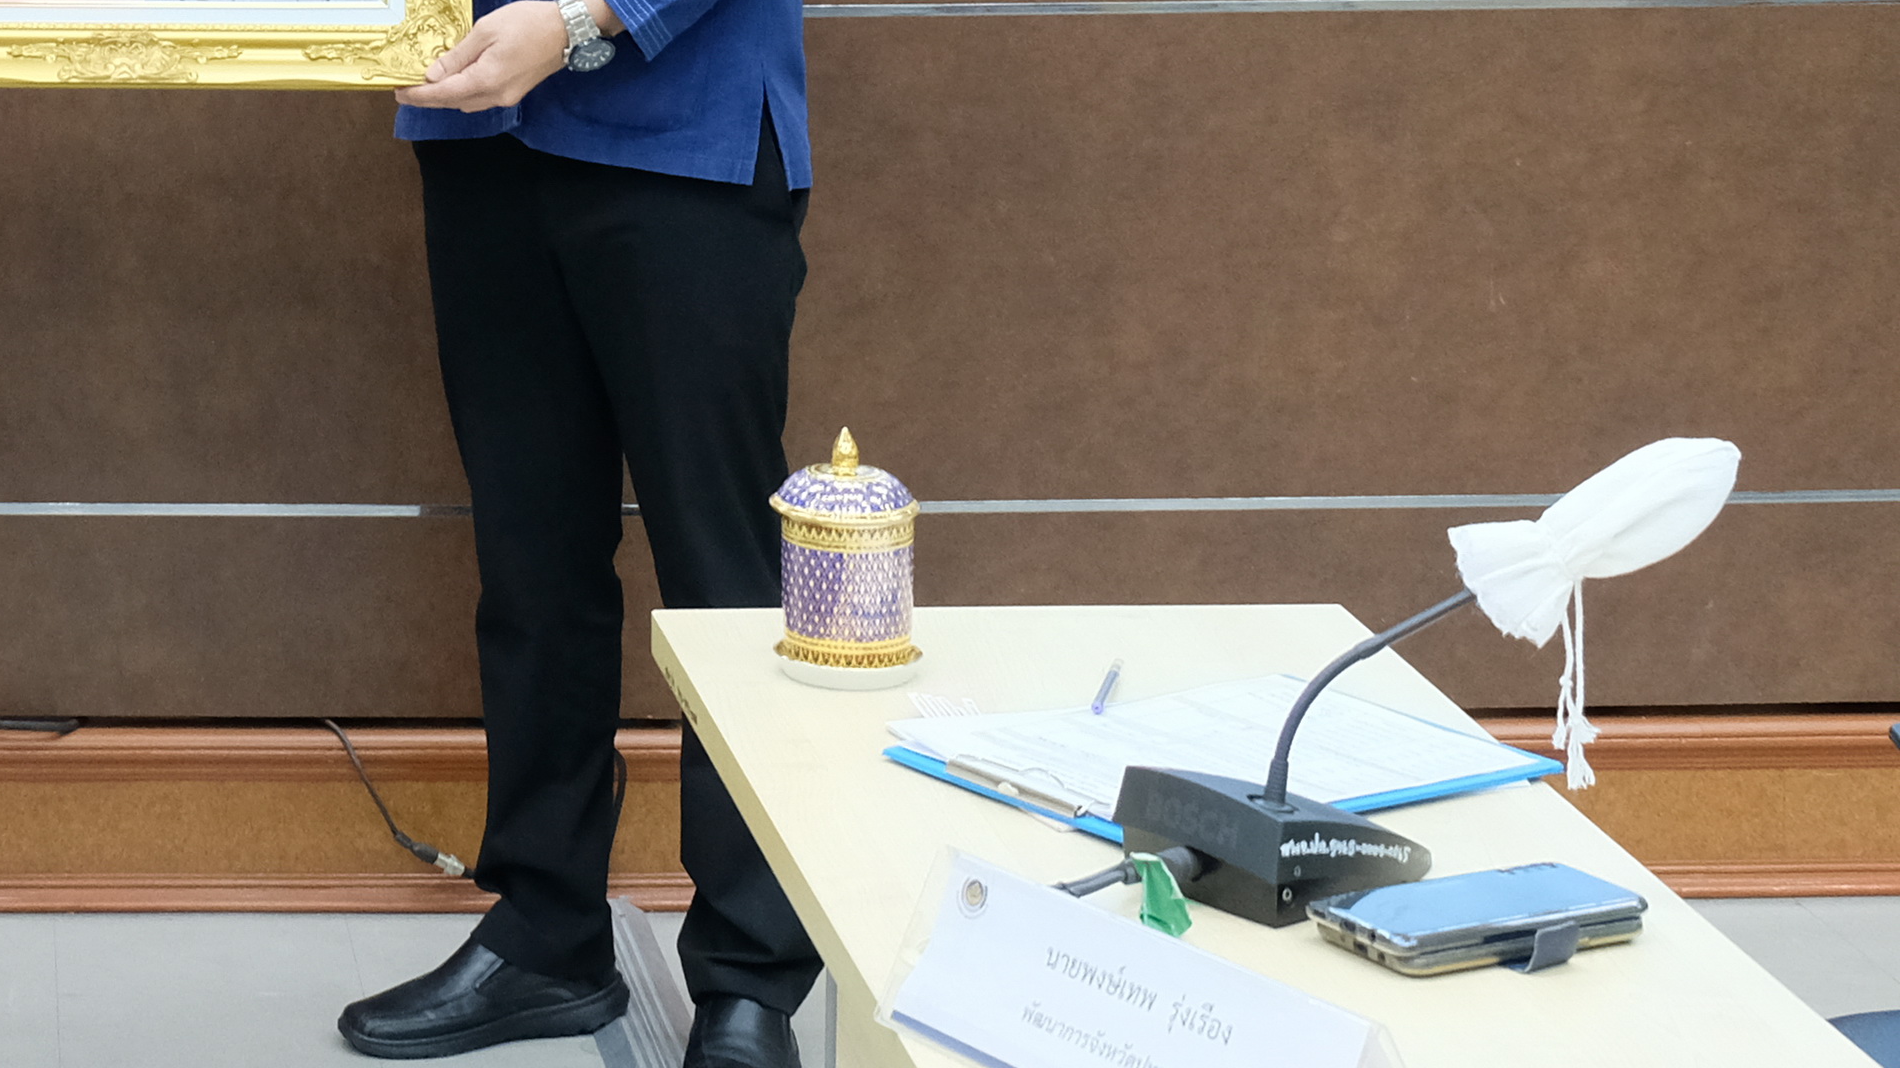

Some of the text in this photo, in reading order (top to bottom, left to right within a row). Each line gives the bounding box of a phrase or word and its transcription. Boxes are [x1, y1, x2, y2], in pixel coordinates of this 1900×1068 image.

[1046, 944, 1232, 1046] นายพงษ์เทพ รุ่งเรือง
